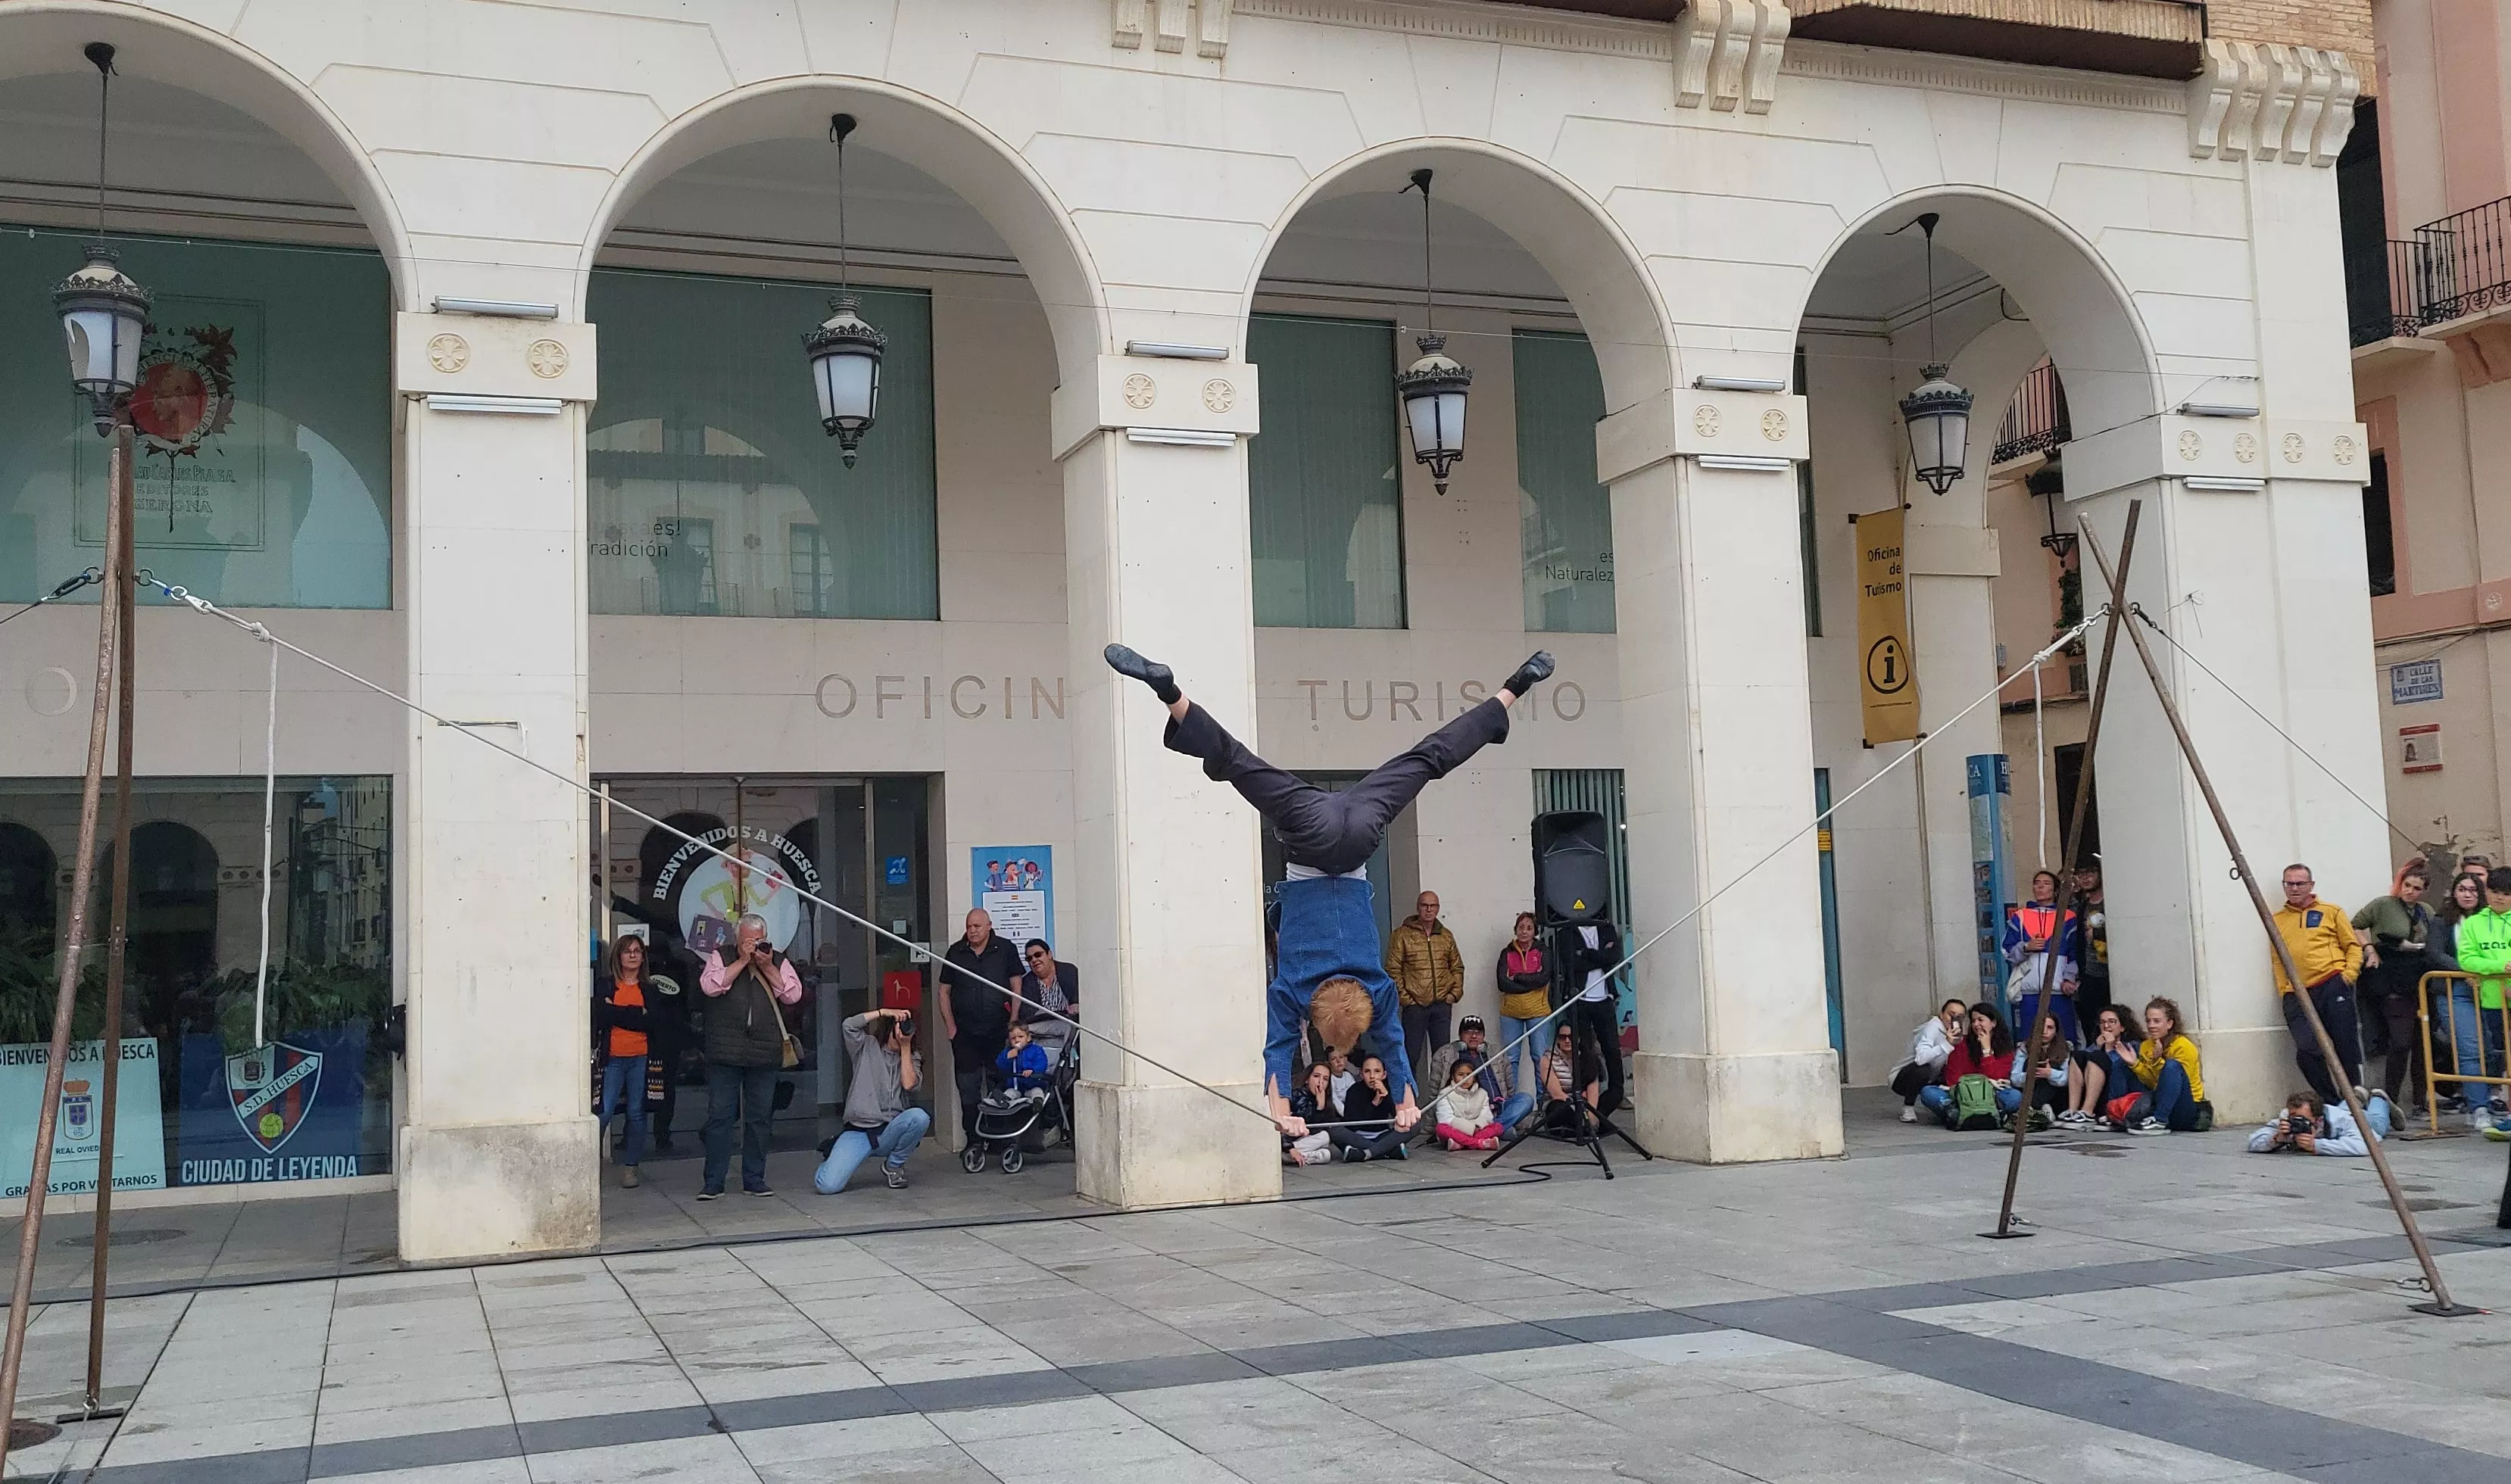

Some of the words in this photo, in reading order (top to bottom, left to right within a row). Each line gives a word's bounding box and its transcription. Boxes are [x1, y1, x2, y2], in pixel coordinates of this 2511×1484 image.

[137, 483, 210, 497] EDITORES
[134, 497, 214, 513] GERONA
[1867, 546, 1901, 562] Oficina
[1889, 562, 1901, 575] de
[1864, 581, 1901, 597] Tuismo
[653, 825, 751, 901] BIENVENIDOS
[754, 828, 767, 843] A
[770, 834, 823, 895] HUESCA
[0, 1046, 87, 1066] IENVENOS
[90, 1046, 99, 1062] A
[103, 1043, 155, 1061] ESCA
[269, 1062, 313, 1098] HUESCA
[77, 1145, 99, 1153] OVIED
[182, 1159, 246, 1183] CIUDAD
[251, 1158, 273, 1181] DE
[278, 1155, 357, 1180] LEYENDA
[5, 1183, 58, 1196] GRAAS
[62, 1180, 86, 1192] POR
